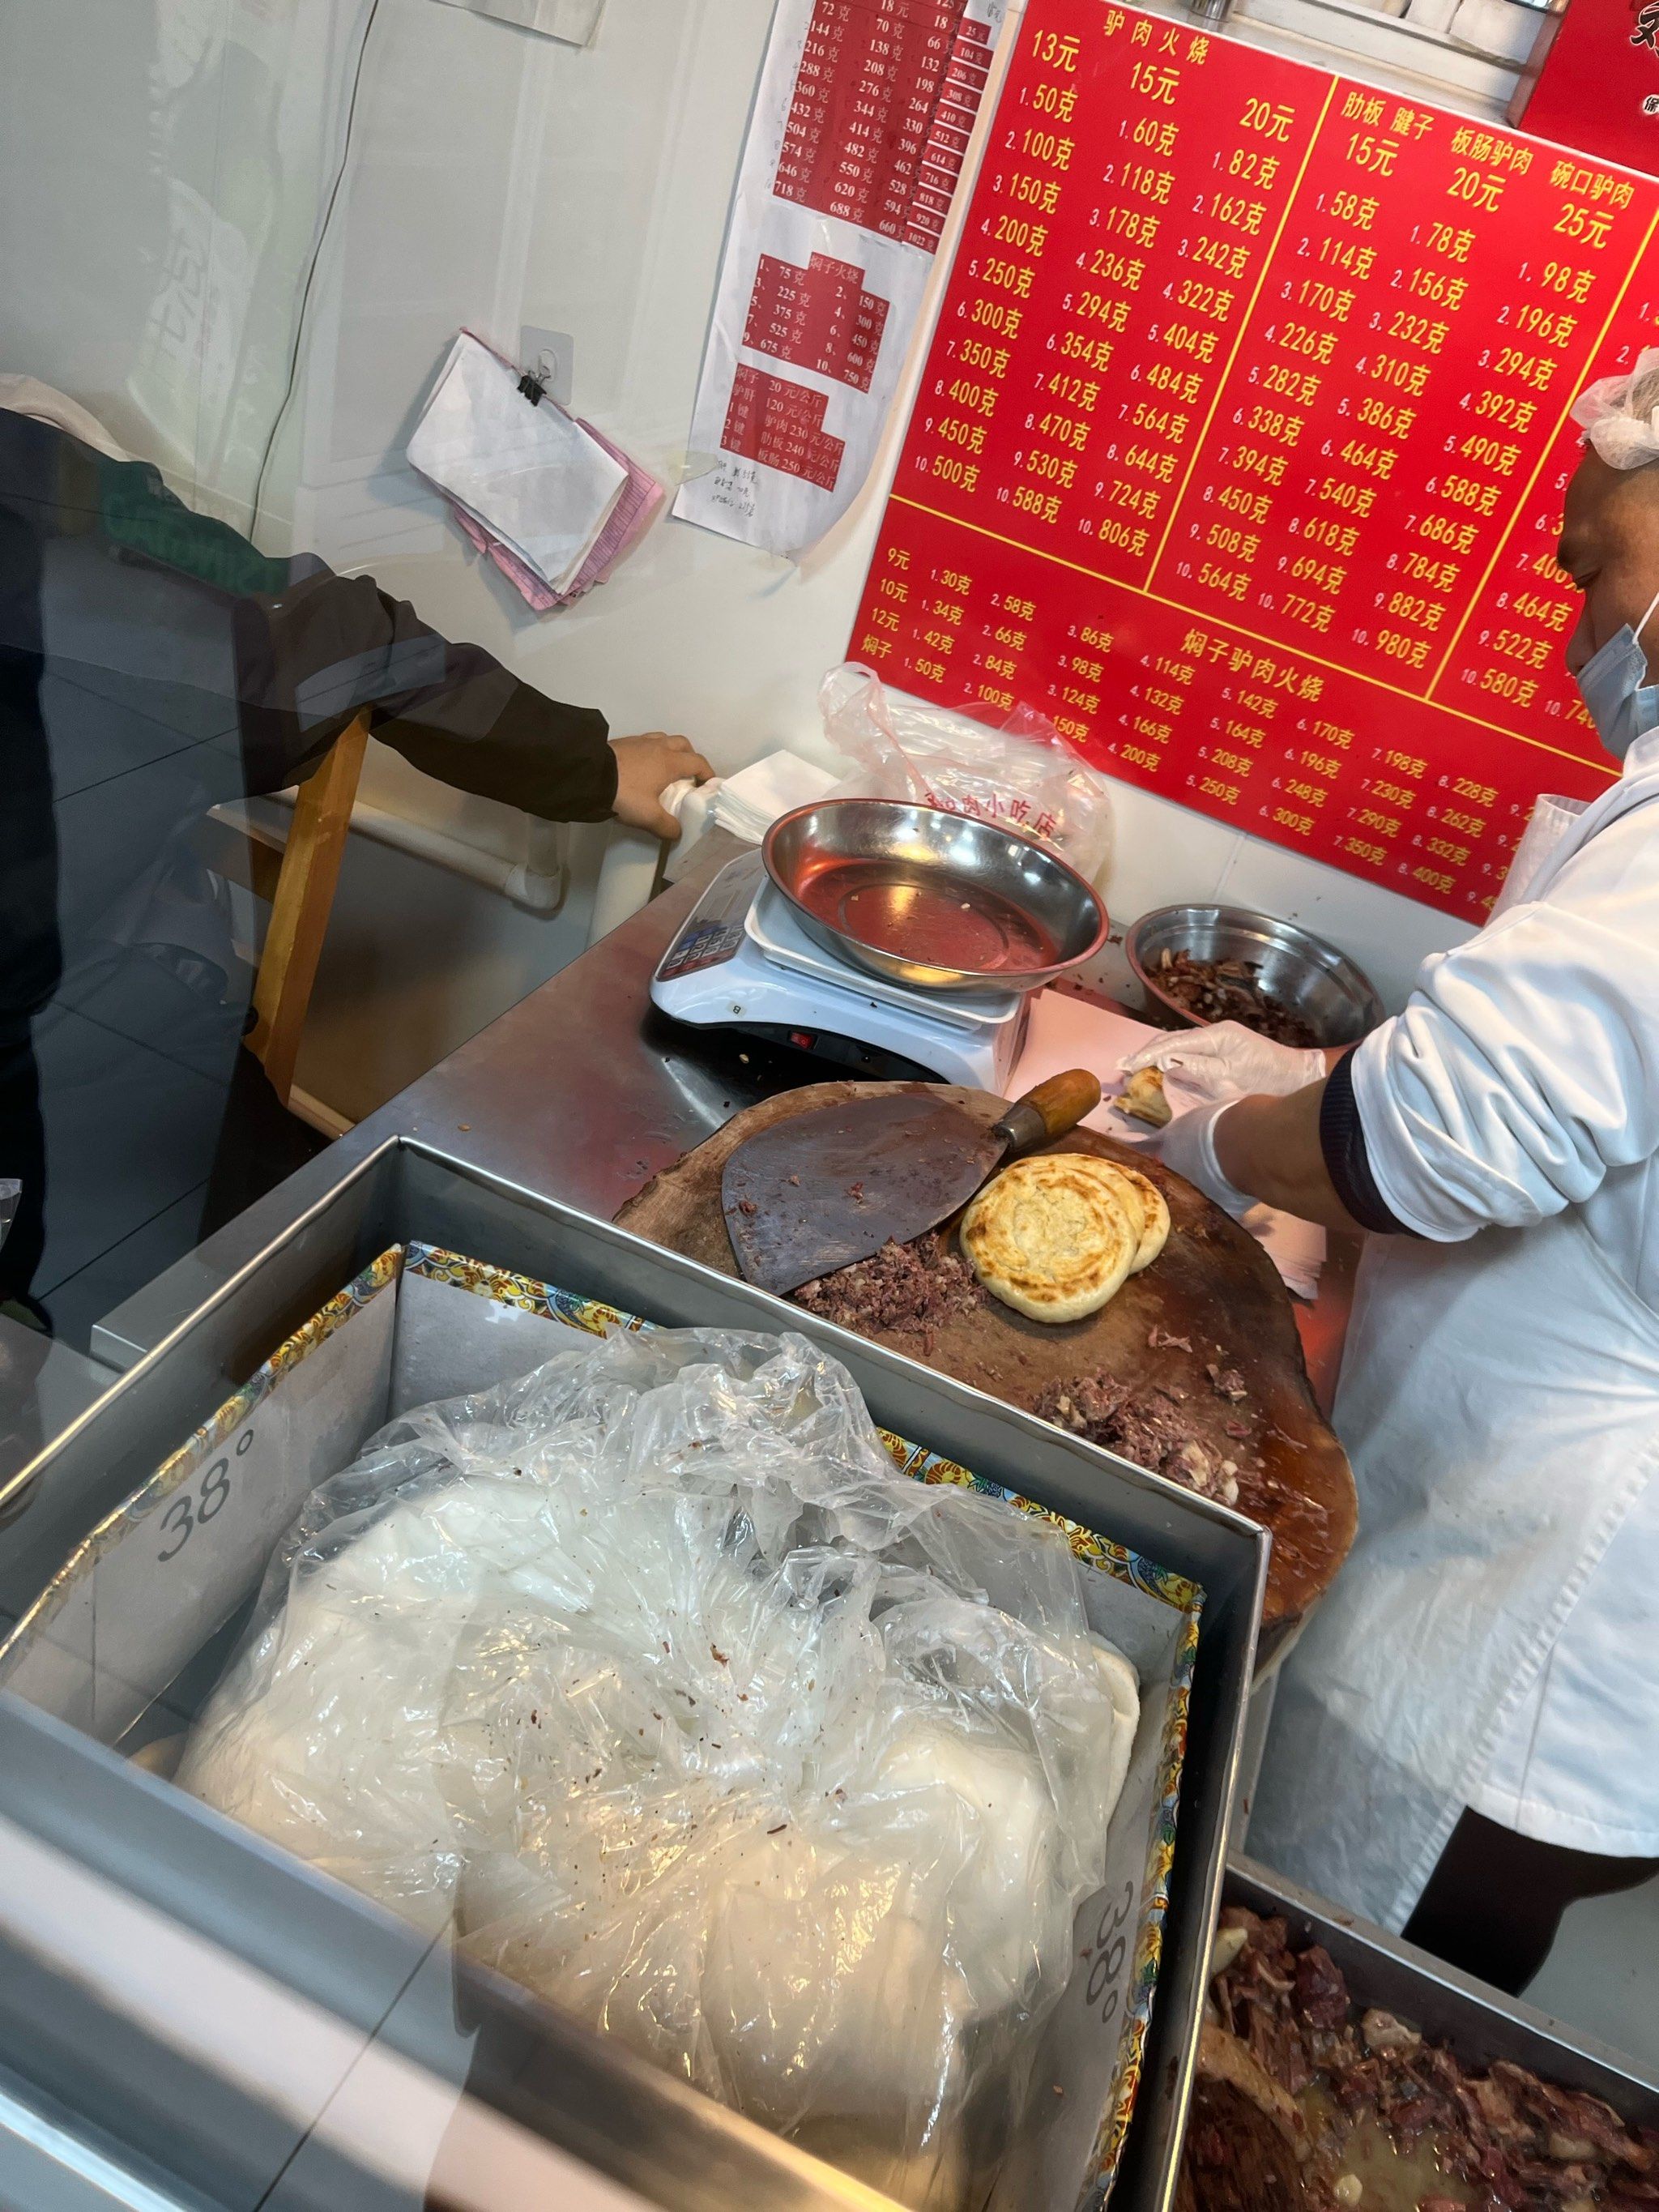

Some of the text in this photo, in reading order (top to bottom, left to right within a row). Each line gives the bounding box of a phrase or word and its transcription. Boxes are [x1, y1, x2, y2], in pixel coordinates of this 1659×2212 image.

[1032, 29, 1081, 73] 13元
[1102, 9, 1210, 66] 驴肉火烧
[1130, 61, 1181, 105] 15元
[1239, 97, 1295, 143] 20元
[1341, 91, 1387, 127] 肋板
[1389, 106, 1435, 141] 腱子
[1346, 132, 1401, 177] 15元
[1450, 126, 1534, 176] 板肠驴肉
[1446, 166, 1507, 213] 20元
[1549, 160, 1636, 211] 碗口驴肉
[1552, 203, 1615, 250] 25元
[887, 547, 911, 571] 9元
[880, 578, 909, 604] 10元
[872, 608, 900, 632] 12元
[861, 634, 892, 659] 焖子
[1179, 628, 1325, 702] 焖子驴肉火烧
